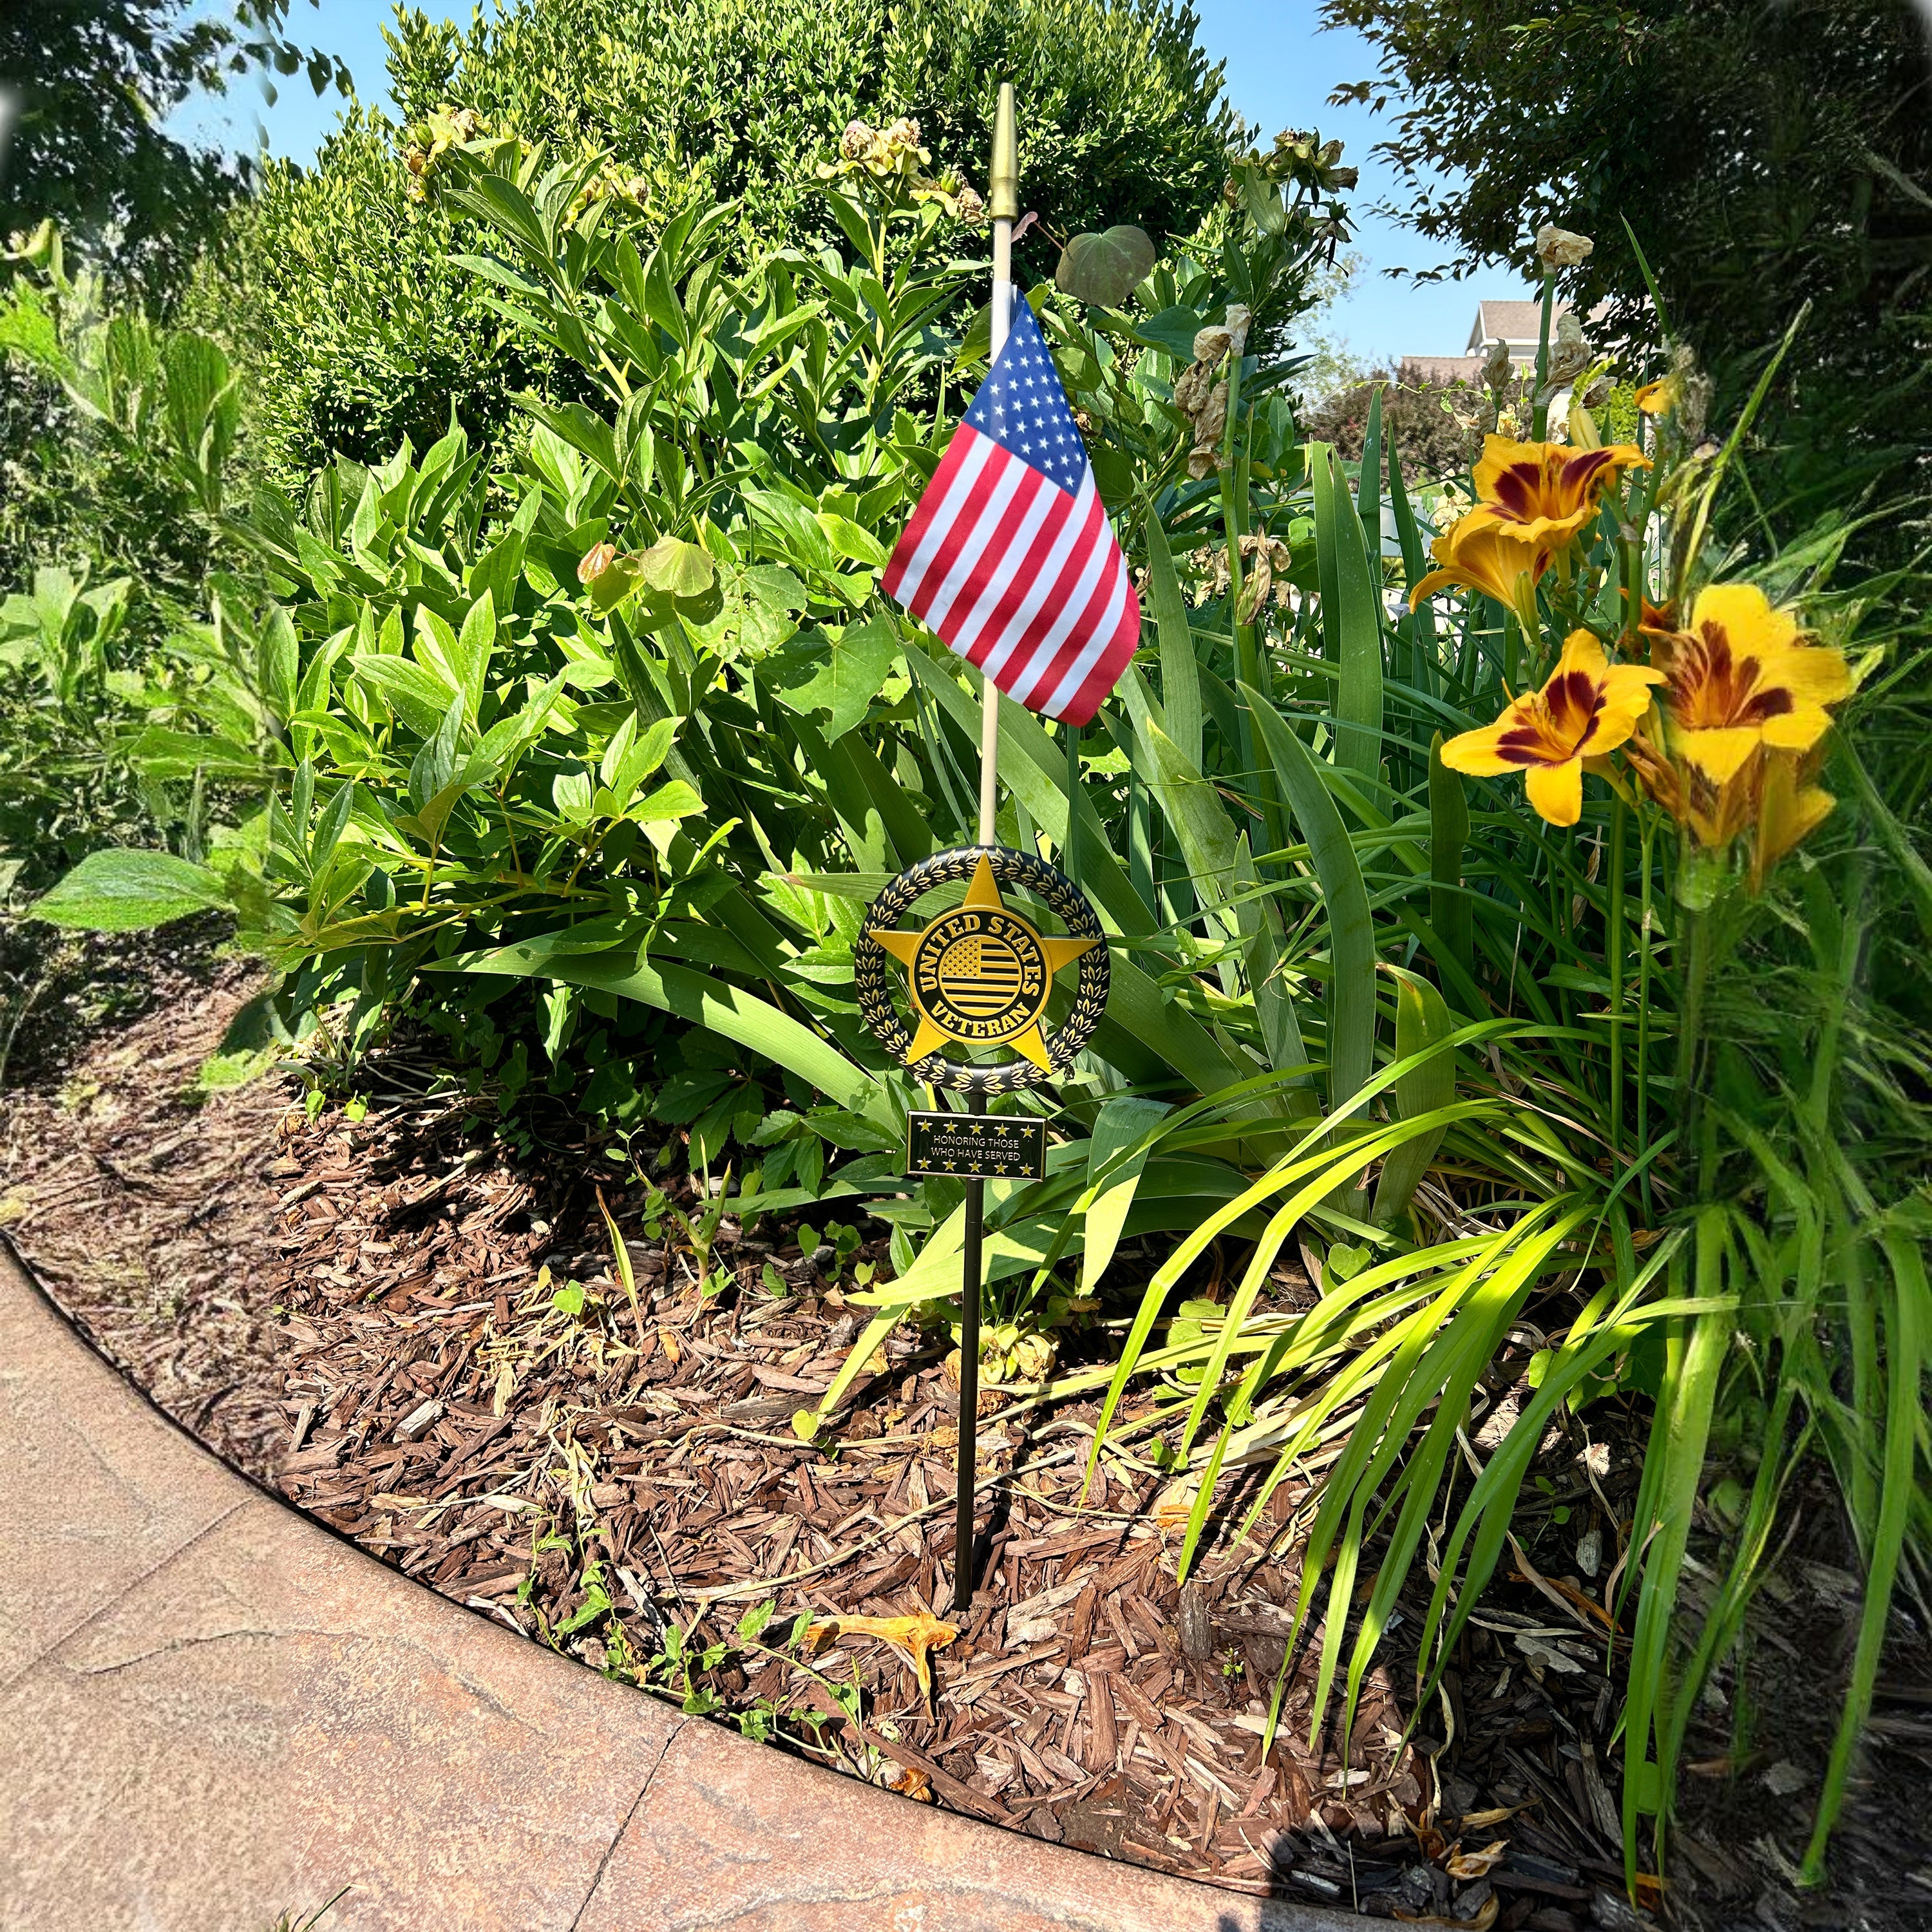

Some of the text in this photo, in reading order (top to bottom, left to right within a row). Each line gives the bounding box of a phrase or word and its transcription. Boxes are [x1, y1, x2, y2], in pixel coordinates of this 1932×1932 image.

[919, 914, 1042, 997] UNITED STATES
[929, 1000, 1031, 1037] VETERAN
[931, 1147, 1021, 1161] WHO HAVE SERVED
[933, 1135, 1019, 1149] HONORING THOSE
